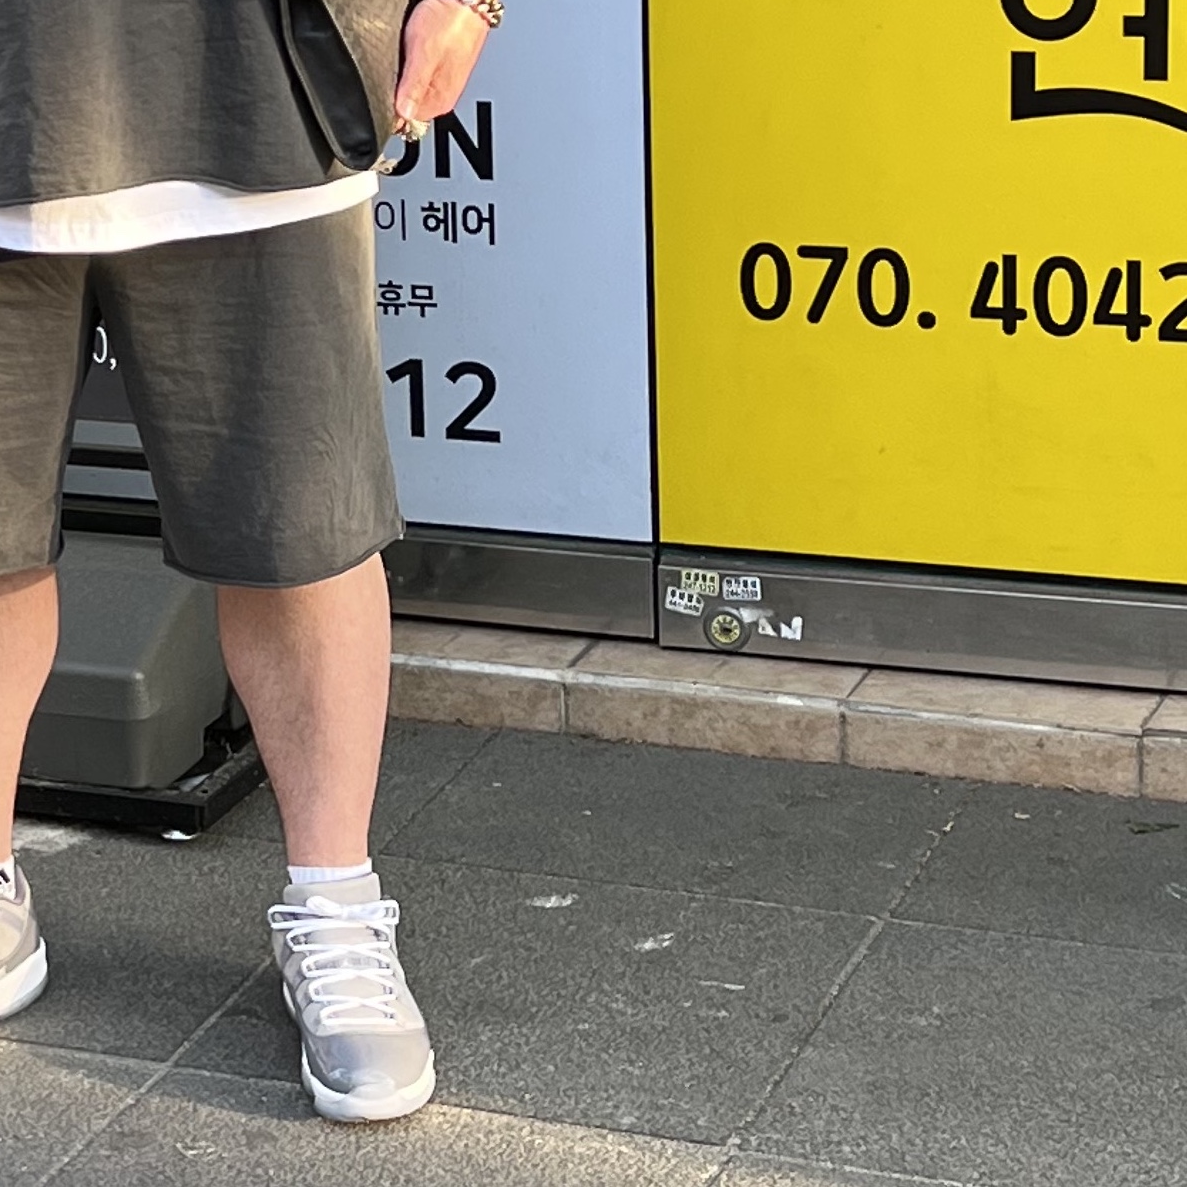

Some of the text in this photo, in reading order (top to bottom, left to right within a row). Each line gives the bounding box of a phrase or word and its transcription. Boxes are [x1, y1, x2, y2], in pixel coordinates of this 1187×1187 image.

[420, 200, 496, 245] 헤어
[375, 279, 438, 318] 휴무
[739, 242, 937, 331] 070.
